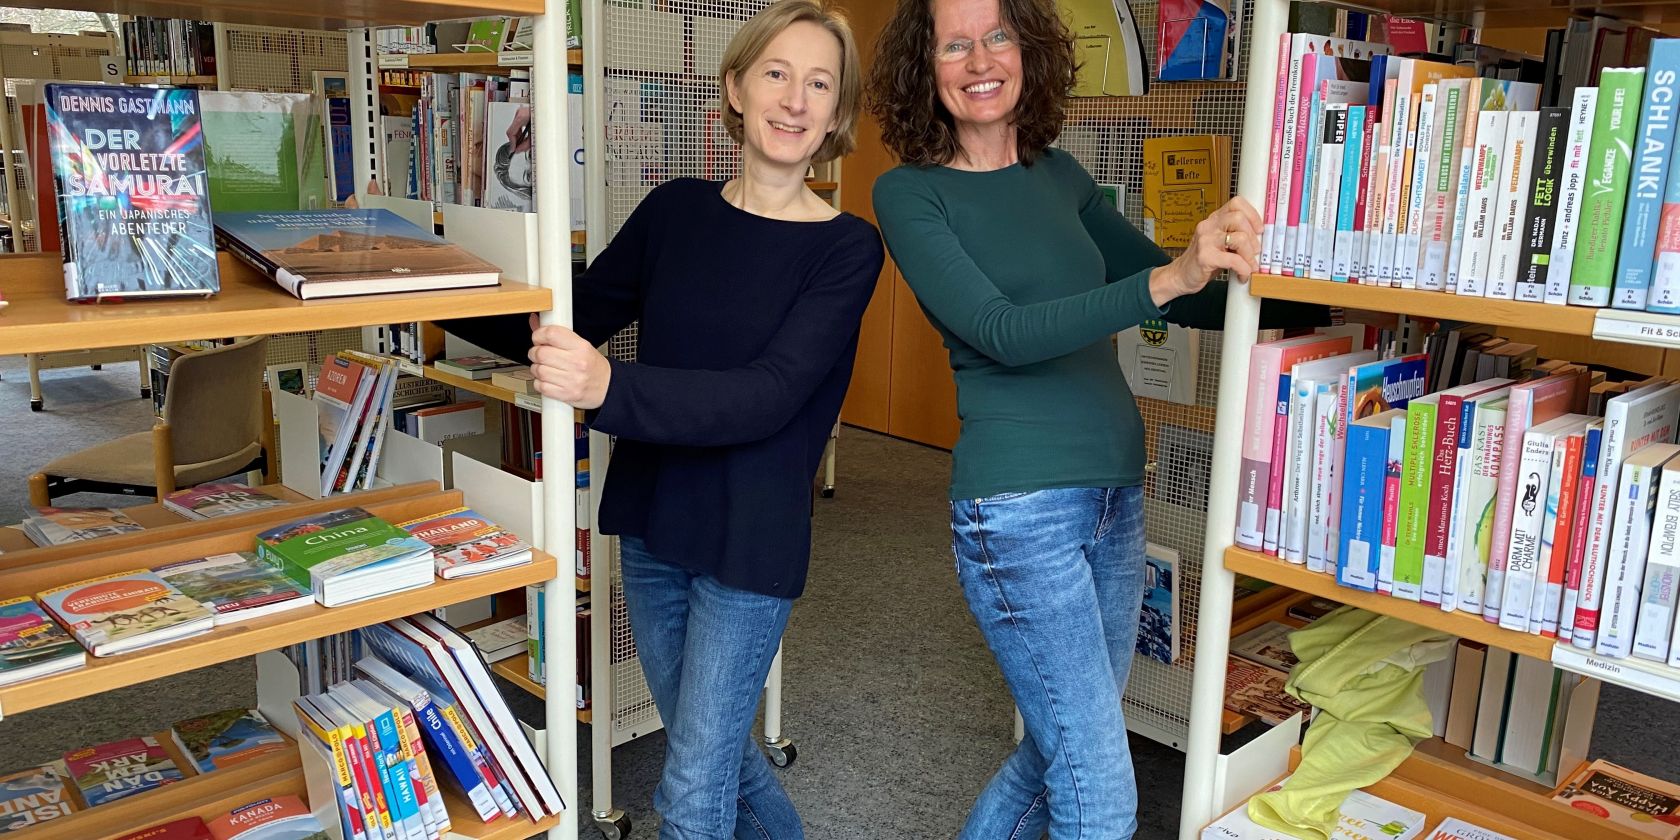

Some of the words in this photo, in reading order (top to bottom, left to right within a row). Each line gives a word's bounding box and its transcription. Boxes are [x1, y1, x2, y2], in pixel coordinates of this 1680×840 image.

[107, 64, 118, 76] S
[60, 96, 115, 112] DENNIS
[119, 98, 195, 115] GASTMANN
[1285, 124, 1294, 146] große
[1291, 59, 1299, 94] Trennkost
[1613, 87, 1626, 108] LIFE!
[1297, 96, 1310, 138] Massage
[1366, 110, 1375, 133] Nacken
[1396, 97, 1406, 148] Vitamin-Revolution
[1579, 102, 1588, 124] HEYNE
[1610, 108, 1622, 131] YOUR
[1335, 112, 1346, 143] PIPER
[1637, 70, 1676, 198] SCHLANK!
[84, 128, 142, 150] DER
[98, 152, 187, 171] VORLETZTE
[1362, 133, 1372, 178] Schwachstelle
[1442, 152, 1451, 164] MIT
[1544, 126, 1558, 175] überwinden
[1574, 145, 1582, 158] mit
[1475, 144, 1487, 190] WEIZENWAMPE
[1510, 139, 1524, 192] WEIZENWAMPE
[1571, 159, 1579, 169] fit
[1591, 148, 1617, 198] VEGANIZE
[69, 174, 203, 196] SAMURAI
[1414, 159, 1426, 208] ACHTSAMKEIT
[1534, 178, 1547, 206] FETT
[1543, 178, 1555, 207] LOGIK
[1567, 172, 1578, 191] jopp
[99, 209, 116, 219] EIN
[122, 209, 190, 220] JAPANISCHES
[1373, 193, 1382, 228] Basenfasten
[1509, 199, 1518, 216] DAVIS
[1565, 192, 1575, 223] andreas
[111, 223, 187, 235] ABENTEUER
[1411, 209, 1420, 235] DURCH
[1435, 216, 1443, 231] DAVID
[1478, 214, 1486, 239] WILLIAM
[1506, 216, 1515, 240] WILLIAM
[1533, 216, 1541, 236] NADJA
[1537, 218, 1547, 248] HERMANN
[1641, 326, 1652, 335] Fit
[1655, 328, 1664, 336] &
[327, 370, 348, 386] AZOREN
[1383, 371, 1424, 403] Heuschnupfen
[1298, 403, 1306, 439] Selbstheilung
[1337, 385, 1348, 440] Wechseljahre
[1611, 419, 1619, 428] Dr.
[1408, 451, 1417, 486] MULTIPLE
[1413, 411, 1421, 450] SKLEROSE
[1417, 451, 1425, 487] erfolgreich
[1421, 412, 1429, 448] behandeln
[1439, 417, 1457, 475] Herz-Buch
[1477, 425, 1486, 453] KAST
[1484, 424, 1494, 464] ERNÄHRUNGS
[1527, 440, 1549, 448] Giulia
[1490, 425, 1505, 479] KOMPASS
[1526, 447, 1549, 455] Enders
[1474, 458, 1482, 476] BAS
[1604, 457, 1612, 477] Klasen
[1249, 469, 1257, 496] Mensch
[1441, 484, 1450, 501] Koch
[1599, 484, 1608, 511] RUNTER
[1439, 501, 1448, 534] Marianne
[1596, 512, 1604, 526] MIT
[305, 526, 368, 545] China
[413, 519, 480, 539] THAILAND
[1515, 528, 1526, 543] MIT
[1594, 527, 1602, 542] DEM
[1511, 543, 1522, 572] DARM
[1521, 534, 1536, 570] CHARME
[1585, 542, 1599, 602] BLUTHOCHDRUCK
[217, 602, 240, 613] NEU
[1586, 657, 1621, 674] Medizin
[394, 712, 402, 730] POLO
[426, 707, 441, 730] Chile
[448, 710, 459, 727] POLO
[332, 733, 341, 752] POLO
[401, 736, 411, 757] MARCO
[460, 729, 473, 748] MARCO
[89, 752, 147, 773] ARK
[377, 754, 385, 770] York
[103, 771, 164, 792] DÄN
[105, 766, 149, 781] EM
[395, 768, 411, 804] HAWAII
[229, 803, 283, 826] KANADA
